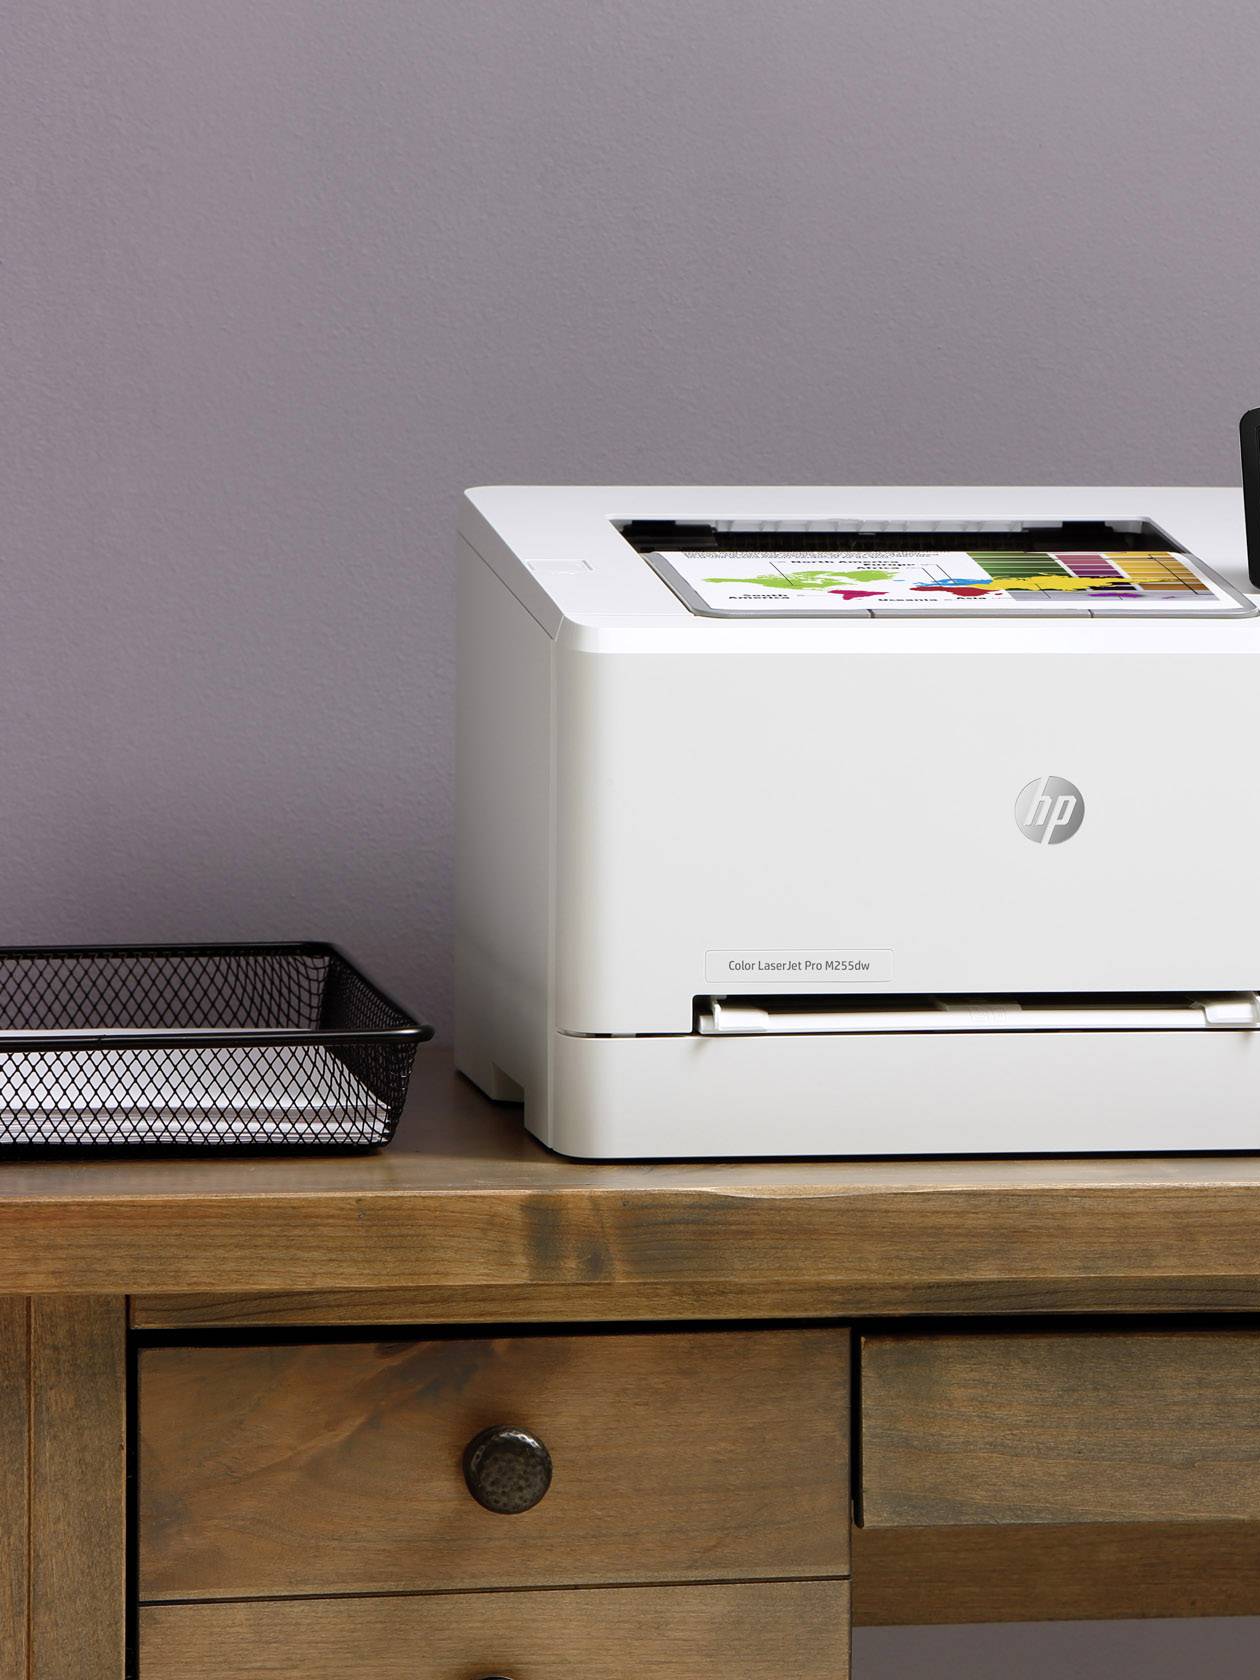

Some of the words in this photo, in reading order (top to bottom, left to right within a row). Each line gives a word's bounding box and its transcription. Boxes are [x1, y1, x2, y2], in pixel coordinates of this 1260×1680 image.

[1020, 776, 1079, 845] hp
[728, 960, 756, 971] Color
[758, 960, 802, 971] LaserJet
[804, 960, 823, 971] Pro
[825, 960, 870, 971] M255dw
